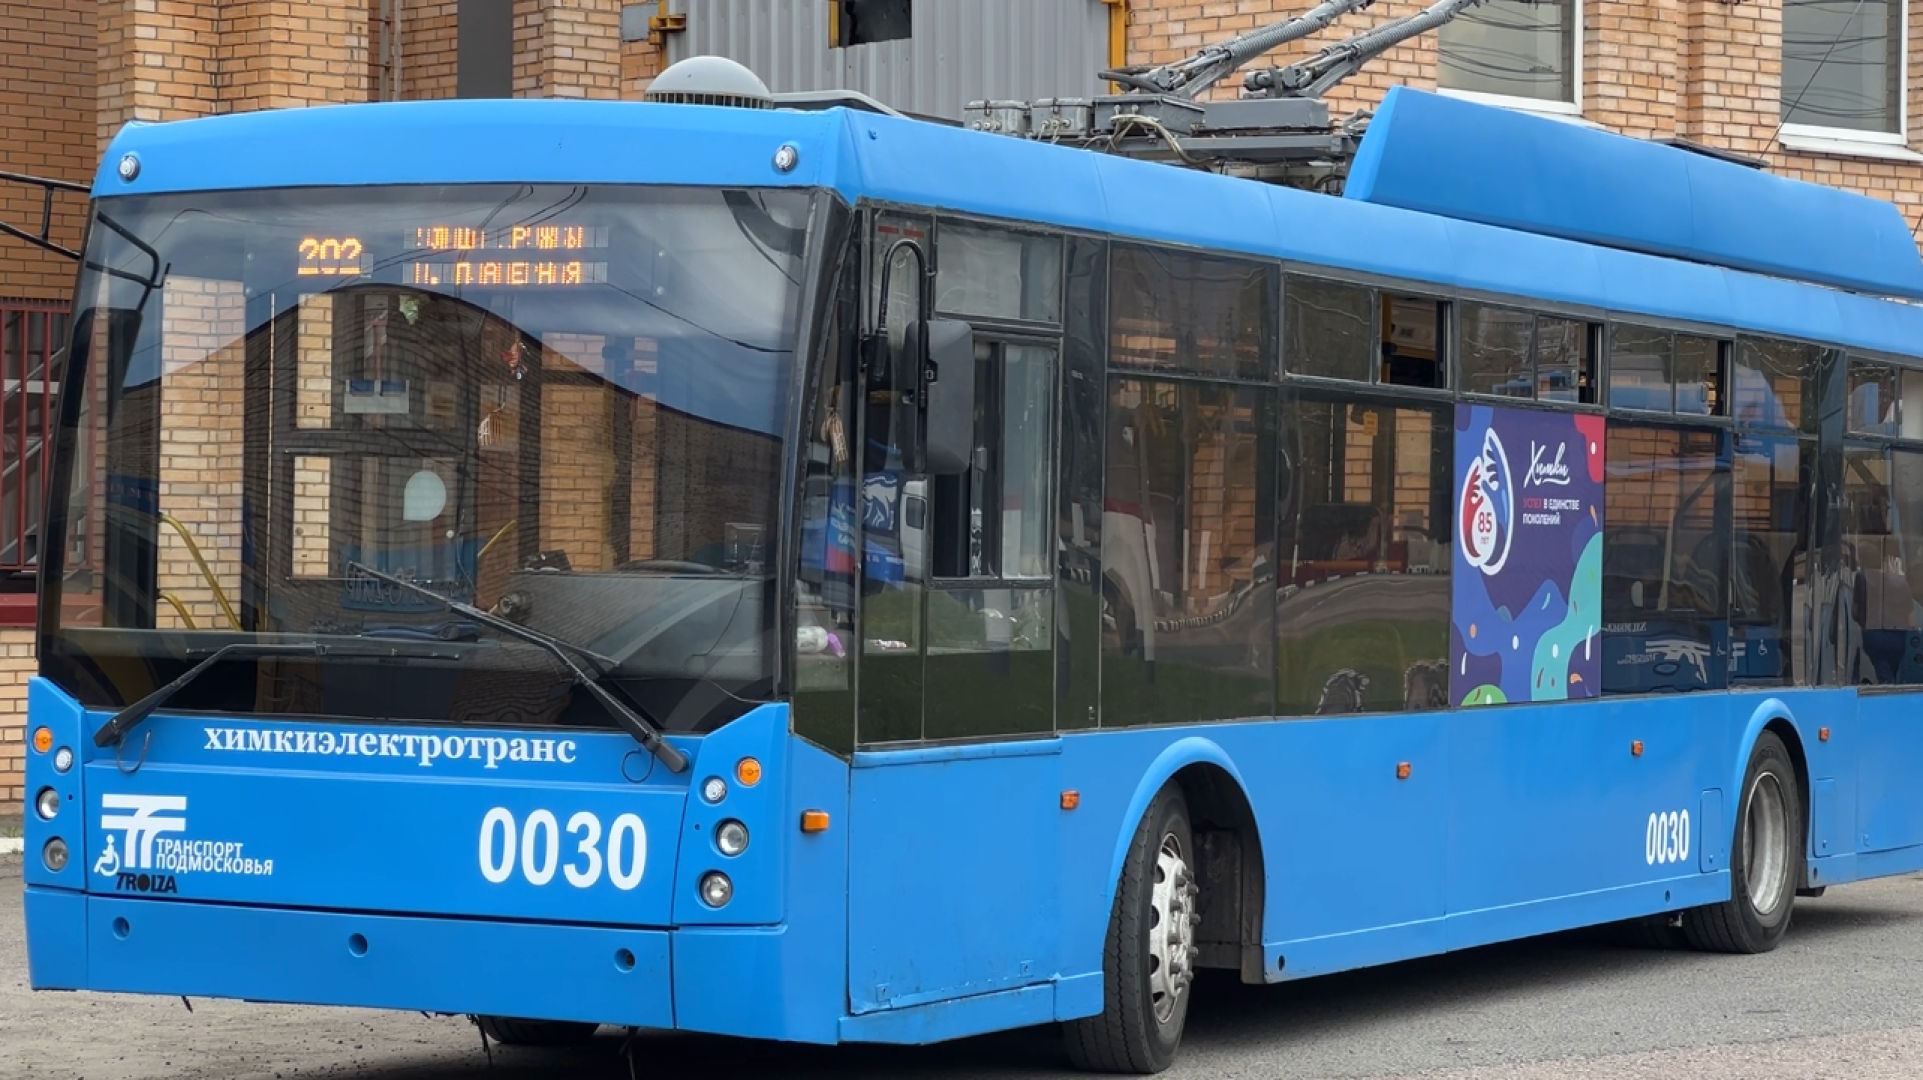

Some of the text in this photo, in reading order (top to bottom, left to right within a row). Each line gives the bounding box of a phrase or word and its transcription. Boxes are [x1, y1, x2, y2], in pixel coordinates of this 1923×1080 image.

[297, 237, 362, 275] 202
[1523, 440, 1571, 488] Химки
[1543, 498, 1548, 509] В
[1549, 498, 1580, 510] ЕДИНСТВЕ
[1478, 511, 1493, 533] 85
[1523, 511, 1561, 525] ПОКОЛЕНИЙ
[155, 838, 243, 858] ТРАНСПОРТ
[1646, 808, 1689, 866] 0030
[478, 806, 647, 891] 0030
[156, 853, 273, 875] ПОДМОСКОВЬЯ
